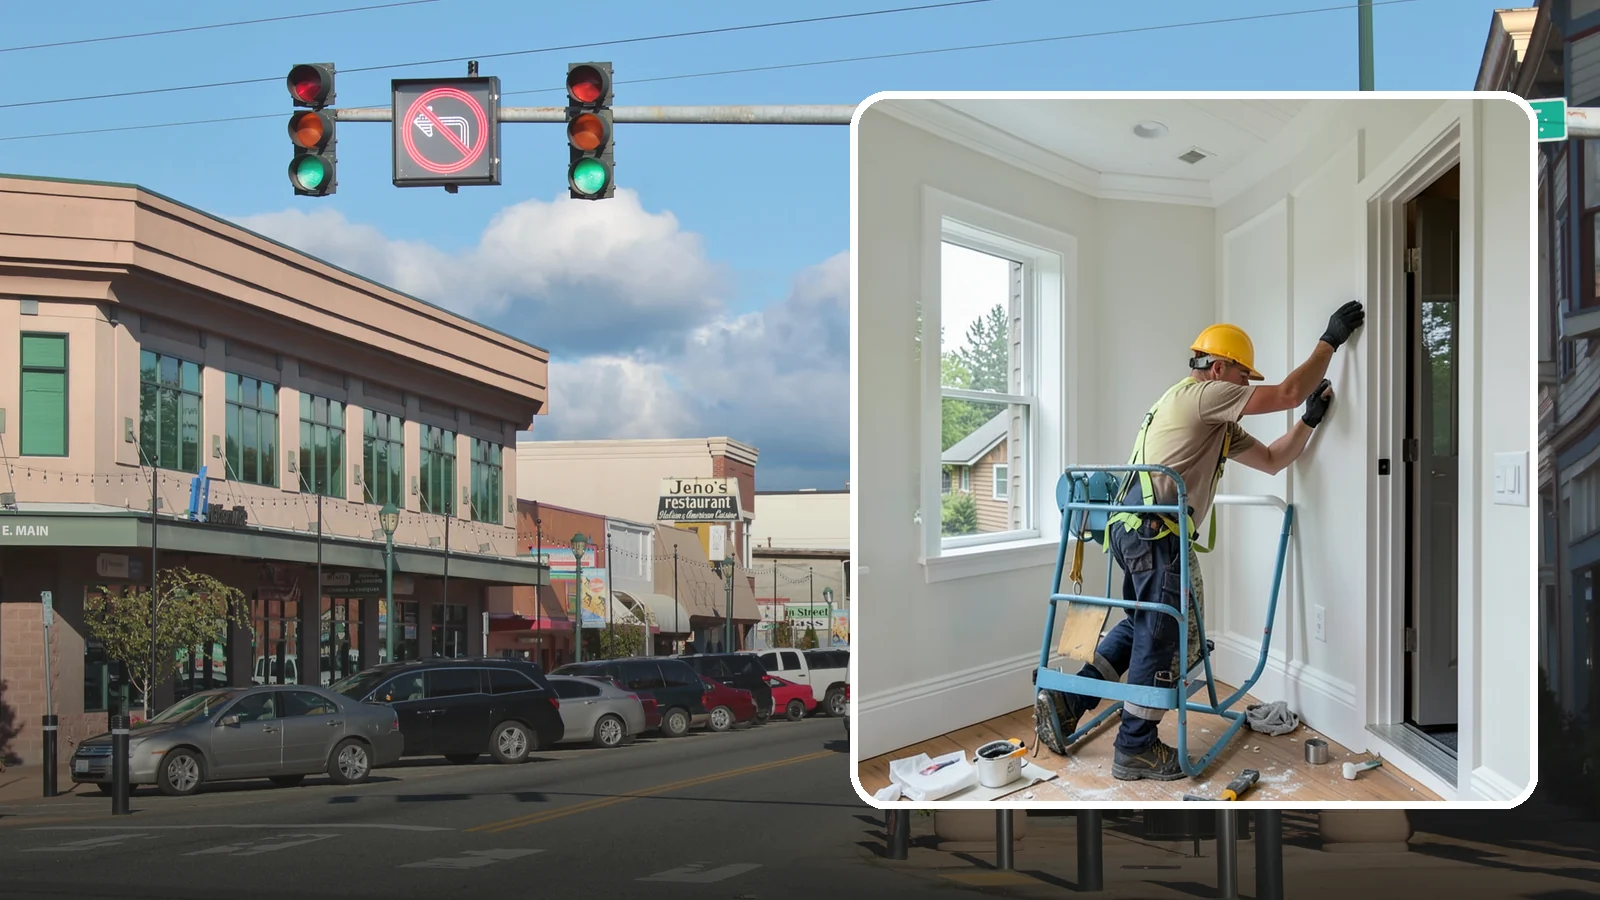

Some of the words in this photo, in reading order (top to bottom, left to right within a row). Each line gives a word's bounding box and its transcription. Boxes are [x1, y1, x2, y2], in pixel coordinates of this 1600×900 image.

[669, 480, 727, 495] Jeno's
[665, 496, 731, 509] restaurant
[658, 510, 682, 520] Italian
[686, 510, 714, 519] American
[715, 509, 737, 519] Cuisine
[2, 525, 13, 536] E.
[15, 525, 49, 536] MAIN
[786, 607, 795, 617] in
[797, 607, 829, 617] Street
[791, 619, 824, 627] lass
